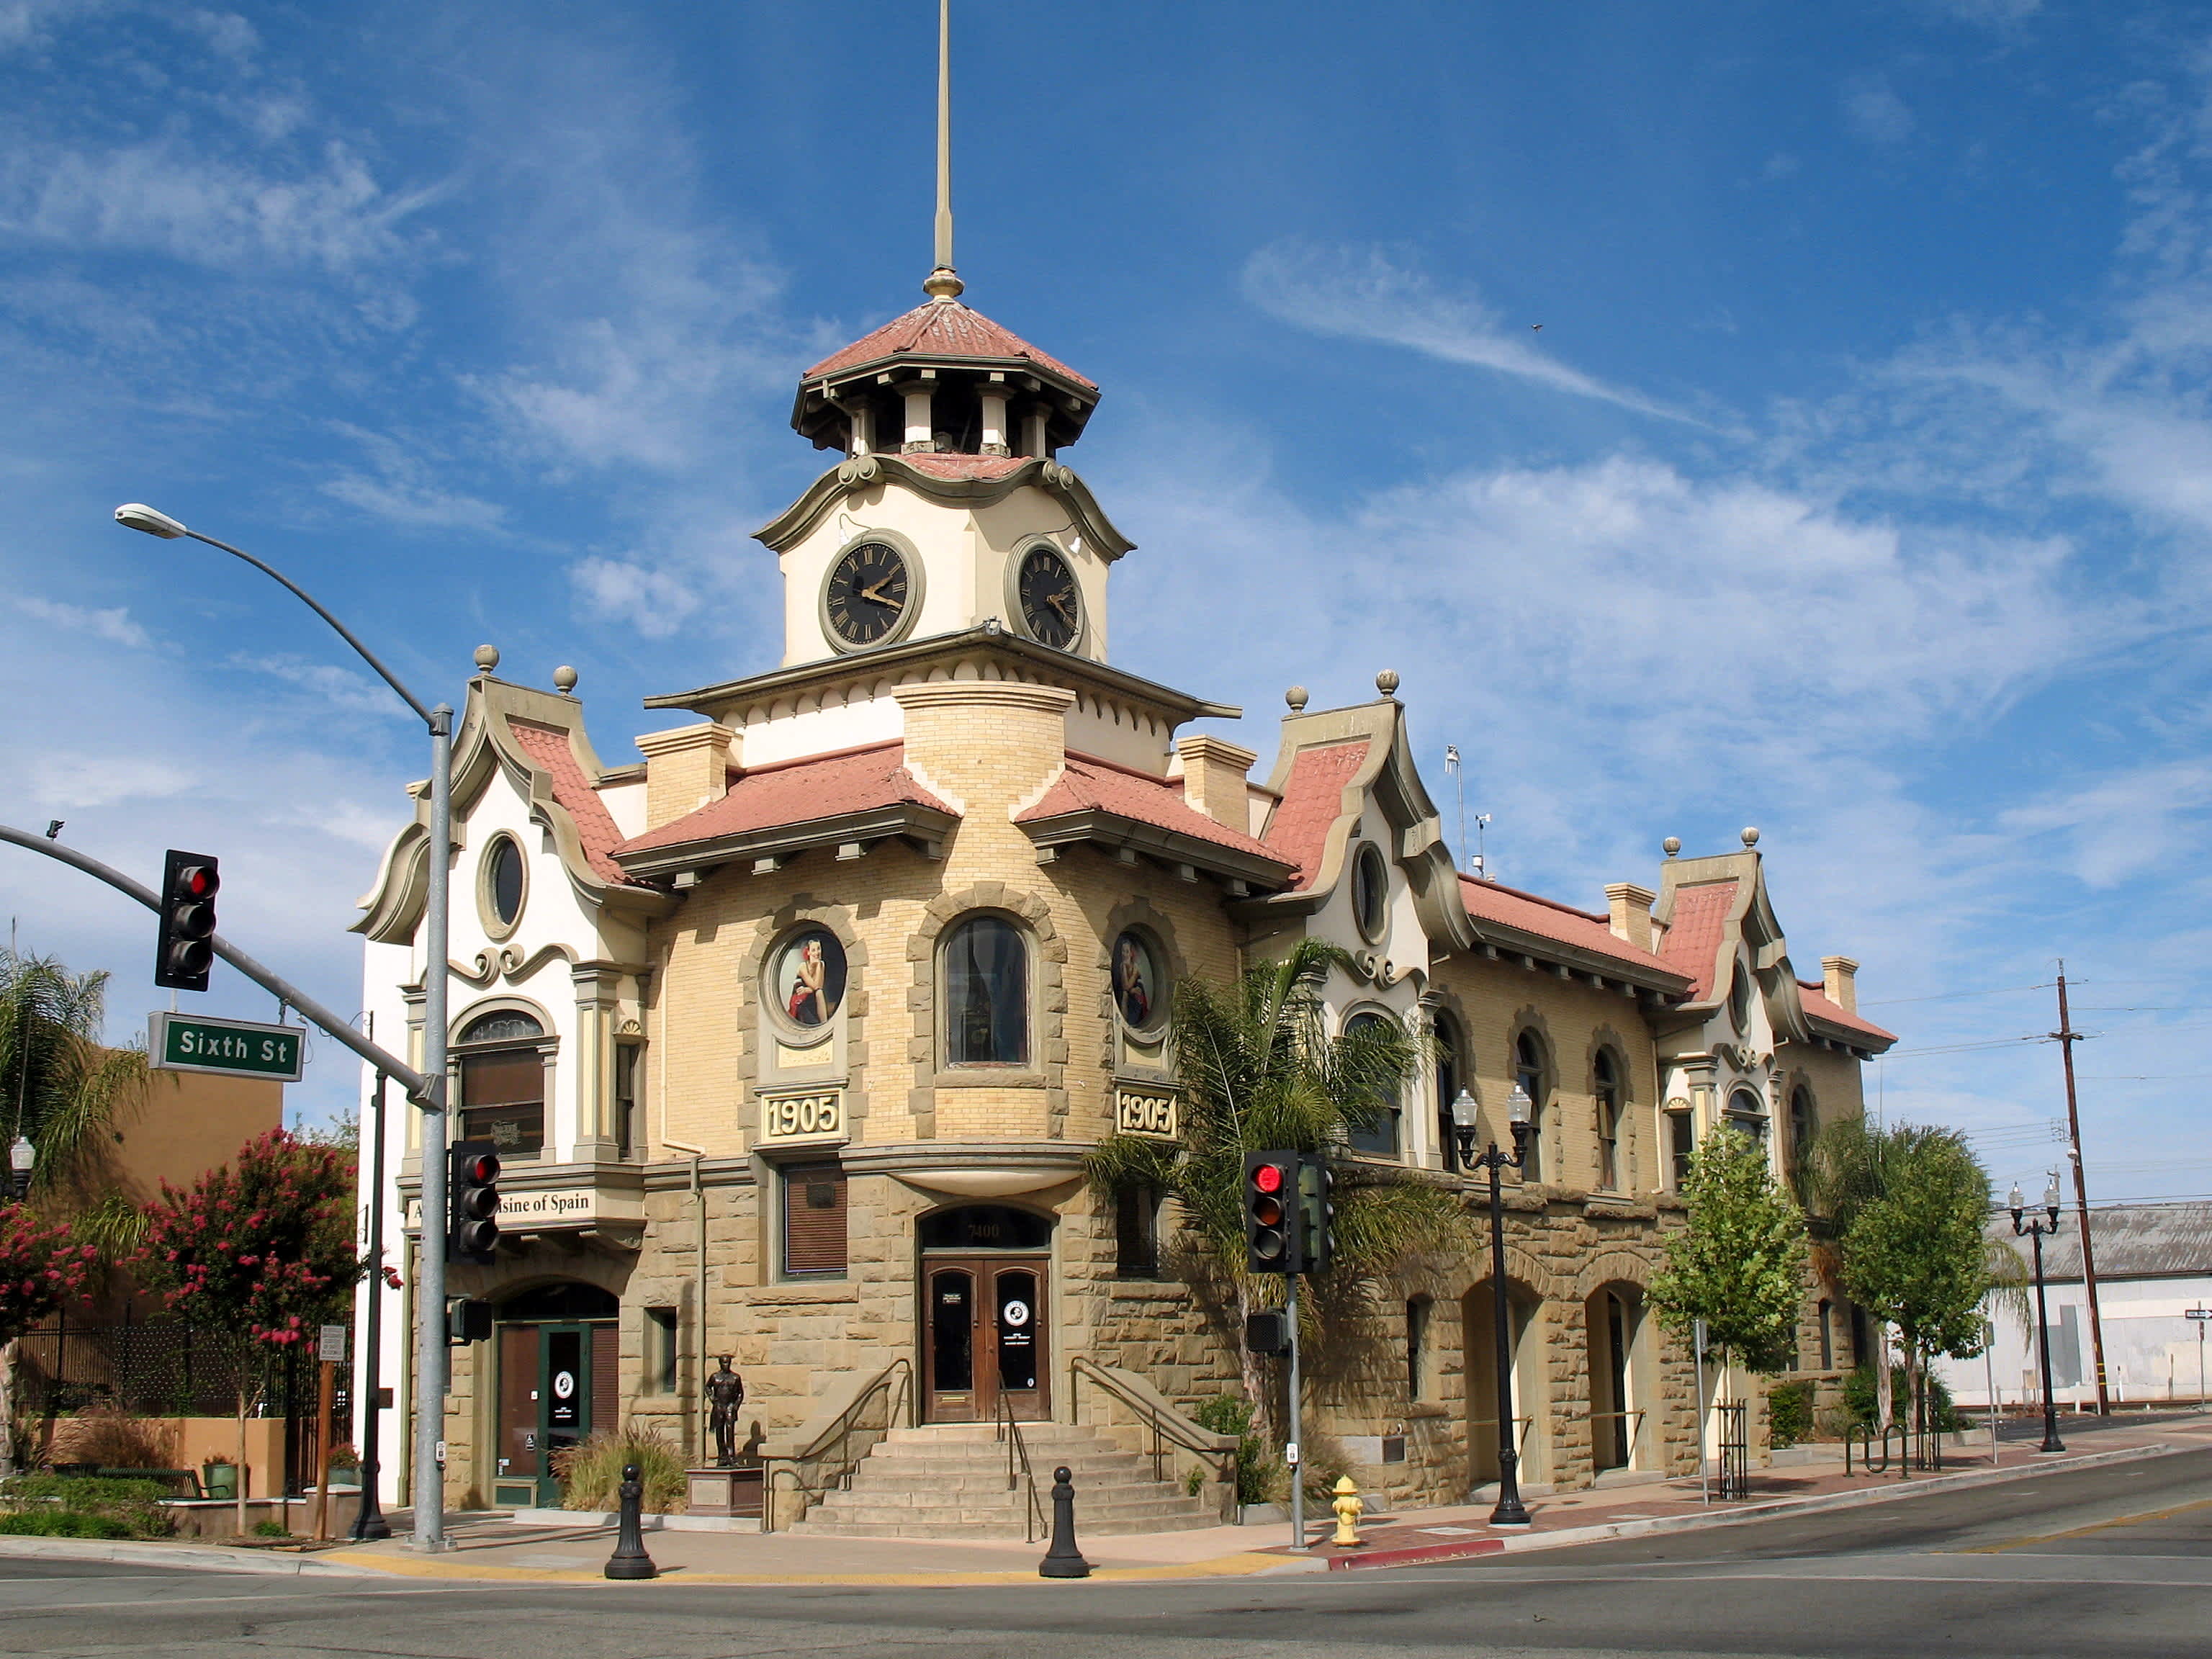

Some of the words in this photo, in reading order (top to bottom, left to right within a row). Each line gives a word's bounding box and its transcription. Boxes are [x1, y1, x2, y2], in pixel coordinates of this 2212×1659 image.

[180, 1030, 247, 1059] Sixth
[260, 1040, 287, 1063] St
[769, 1097, 837, 1136] 1905
[1122, 1094, 1172, 1132] 1905
[498, 1197, 530, 1213] isine
[533, 1195, 548, 1211] of
[551, 1193, 589, 1215] Spain
[968, 1224, 999, 1238] 7400
